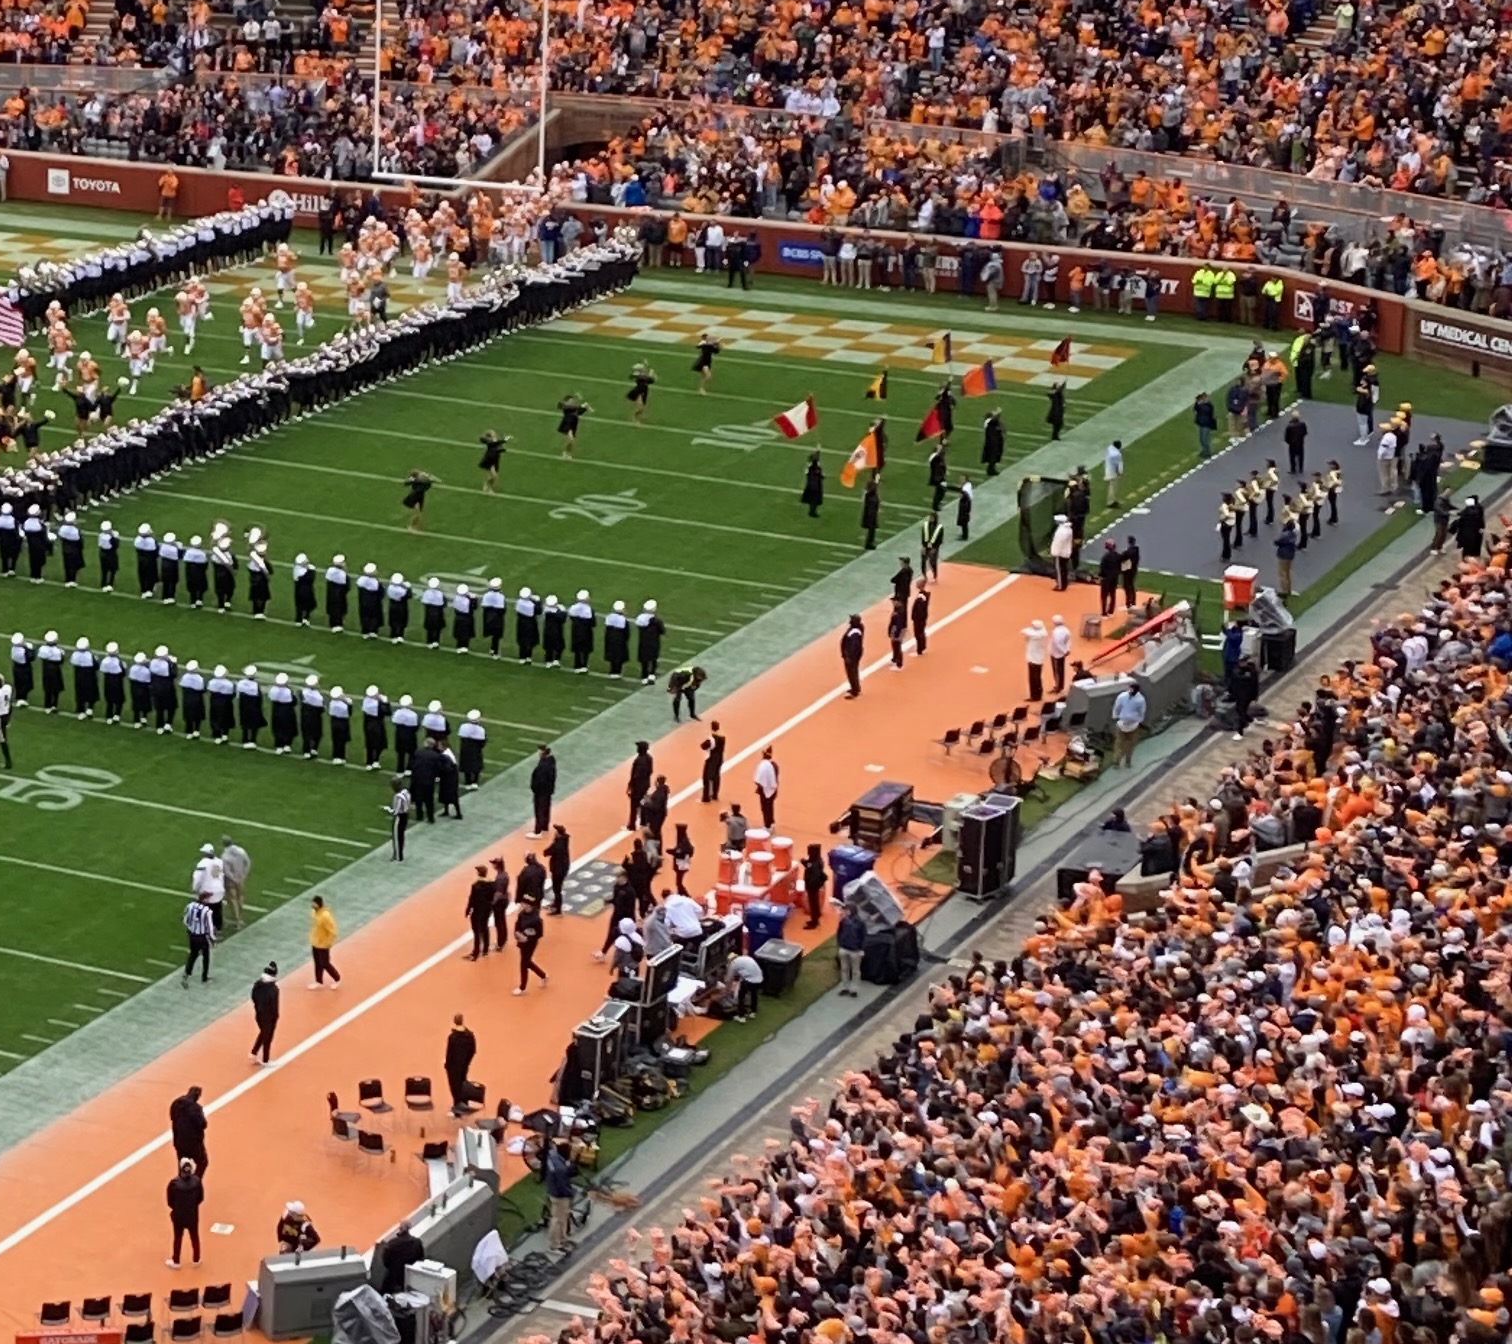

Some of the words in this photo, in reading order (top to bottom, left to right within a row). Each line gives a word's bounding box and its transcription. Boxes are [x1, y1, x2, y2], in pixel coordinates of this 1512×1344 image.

[73, 177, 121, 194] TOYOTA
[1437, 323, 1488, 348] MEDICAL
[690, 424, 780, 453] 10
[549, 494, 647, 526] 20
